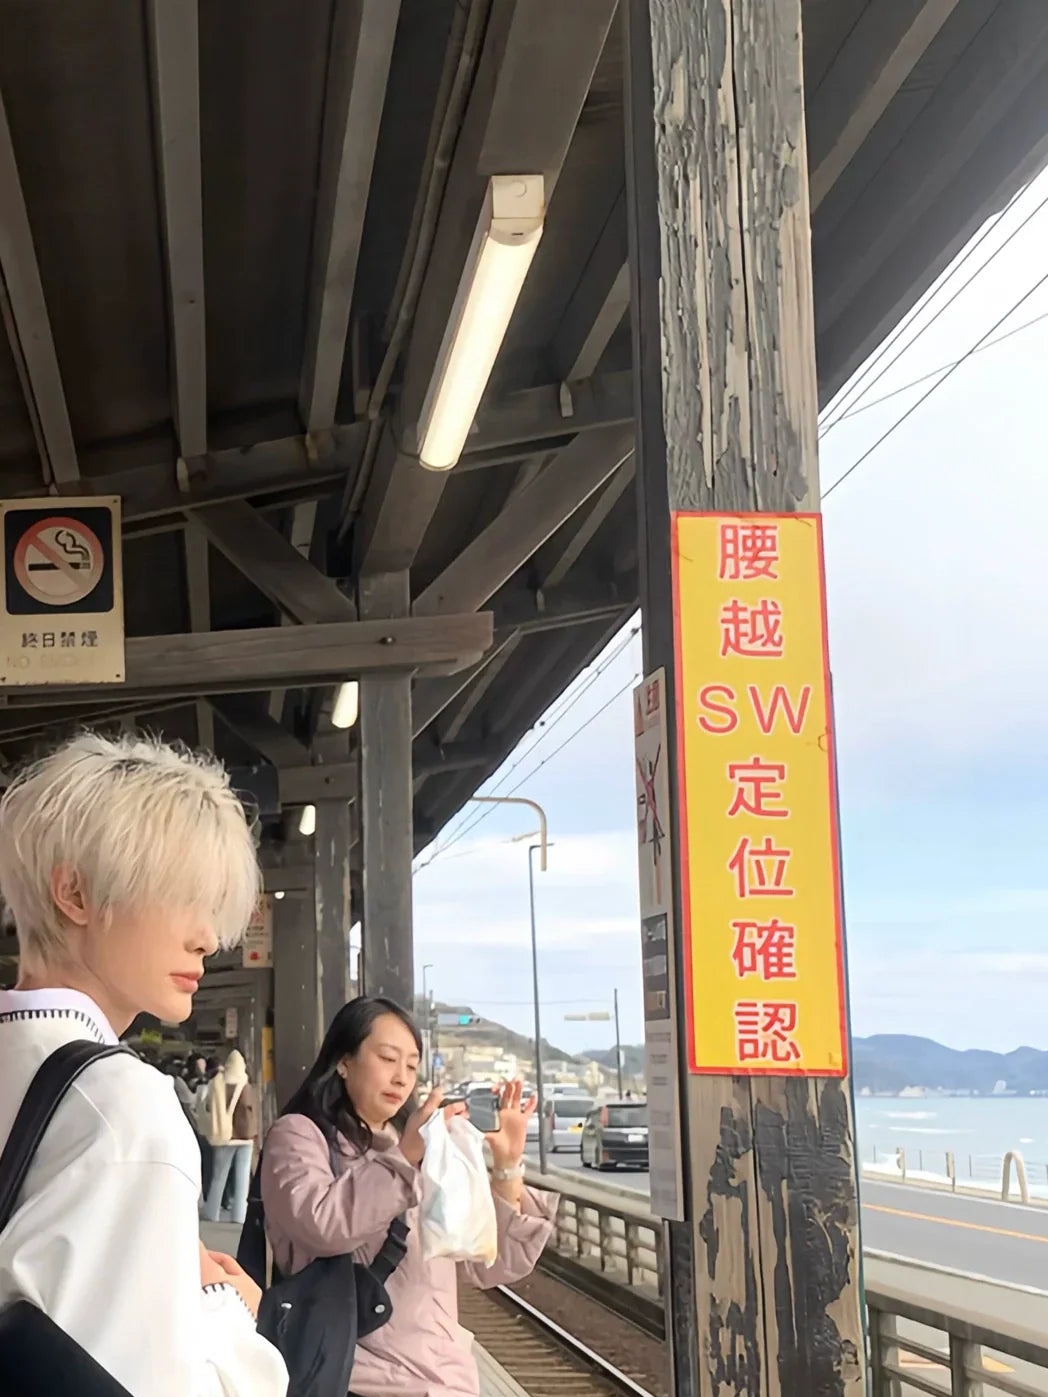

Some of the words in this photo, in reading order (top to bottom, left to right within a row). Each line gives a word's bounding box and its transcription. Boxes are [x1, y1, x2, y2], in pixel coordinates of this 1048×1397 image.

[21, 630, 99, 649] 終日禁煙
[697, 523, 812, 1062] 腰越SW定位確認
